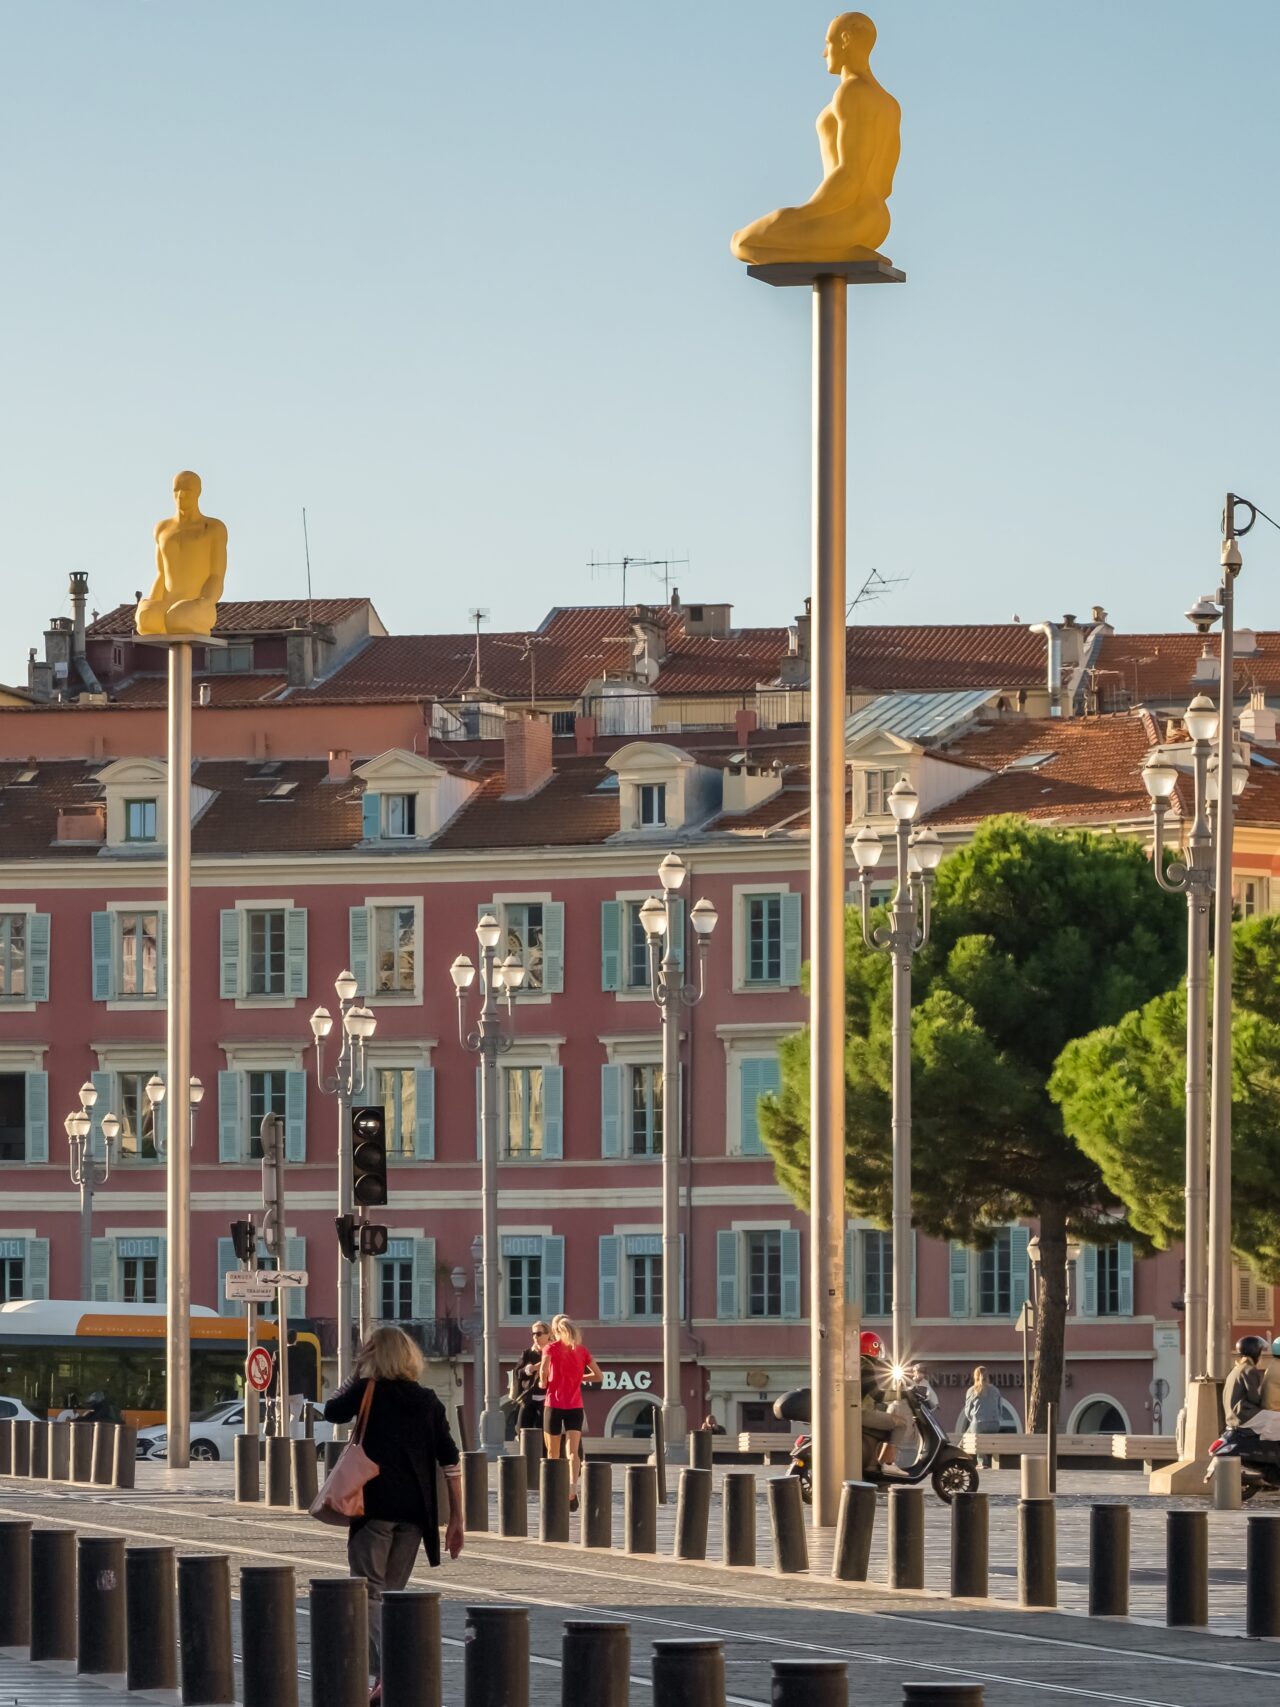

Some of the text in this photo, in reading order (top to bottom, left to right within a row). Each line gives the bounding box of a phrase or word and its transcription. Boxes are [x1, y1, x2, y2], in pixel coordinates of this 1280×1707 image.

[120, 1239, 157, 1256] HOTEL
[387, 1239, 412, 1257] OTEL
[503, 1238, 540, 1255] HOTEL
[601, 1371, 651, 1389] BAG
